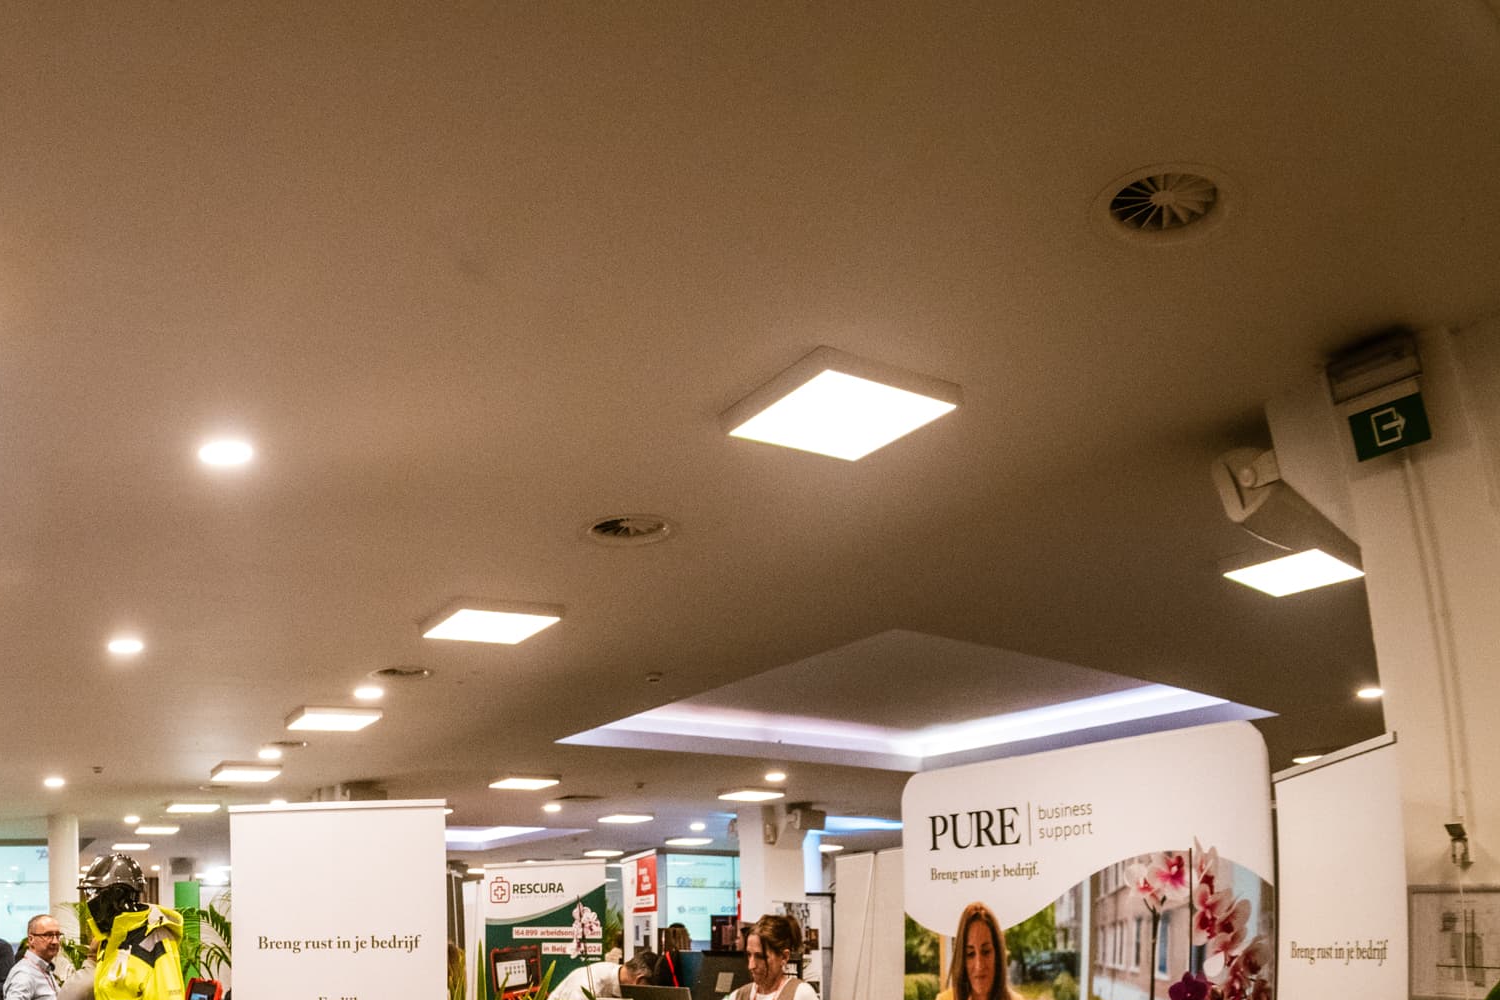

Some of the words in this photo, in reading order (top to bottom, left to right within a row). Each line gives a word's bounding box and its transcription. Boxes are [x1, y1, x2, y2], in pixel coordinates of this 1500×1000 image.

[1038, 803, 1092, 820] business
[928, 807, 1021, 851] PURE
[1039, 821, 1093, 840] support
[930, 867, 957, 884] Breng
[959, 867, 978, 880] rust
[980, 865, 991, 879] in
[991, 864, 1001, 882] je
[1003, 861, 1040, 881] bedrijf.
[512, 882, 564, 895] RESCURA
[258, 935, 301, 953] Breng
[305, 937, 334, 949] rust
[337, 936, 351, 949] in
[352, 935, 367, 953] je
[371, 934, 422, 953] bedrijf
[1290, 941, 1316, 965] Breng
[1316, 946, 1333, 960] rust
[1334, 941, 1345, 960] in
[1344, 941, 1355, 966] je
[1355, 939, 1389, 967] bedrijf
